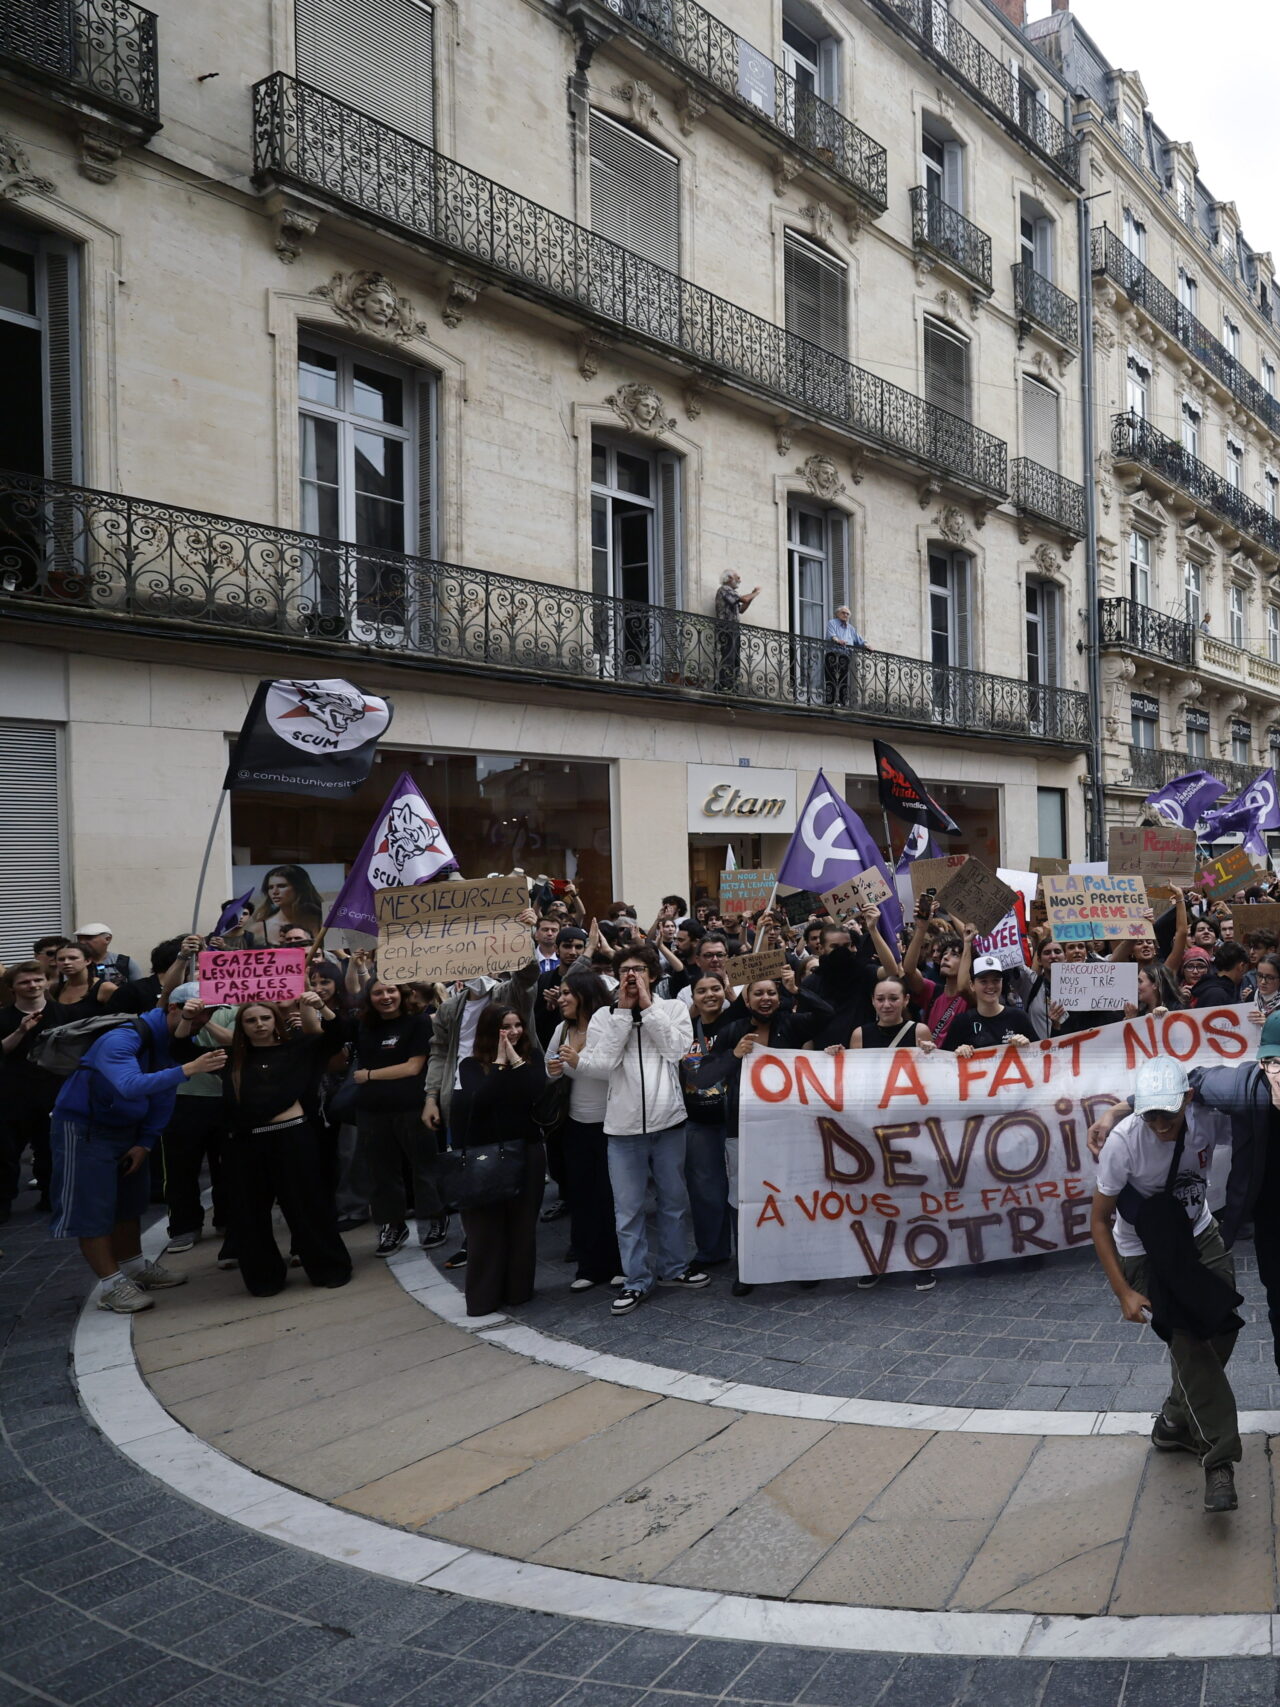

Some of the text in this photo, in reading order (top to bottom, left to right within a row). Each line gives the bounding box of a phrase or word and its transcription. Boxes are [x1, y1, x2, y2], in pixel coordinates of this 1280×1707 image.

[291, 730, 340, 750] SCUM
[703, 784, 787, 817] Etam
[1050, 876, 1078, 893] LA
[492, 887, 525, 905] LES
[1050, 892, 1144, 907] NOUS PROTÈGE
[1078, 905, 1127, 919] CRÈVE
[1053, 924, 1101, 939] YEUX
[484, 935, 526, 956] RIO
[212, 952, 276, 967] GAZEZ
[425, 965, 442, 977] un
[445, 960, 484, 976] fashion
[1061, 964, 1116, 975] PARCOURSUP
[215, 978, 287, 993] PAS LES
[1060, 976, 1079, 986] NOUS
[1060, 985, 1088, 994] L'ÉTAT
[1058, 998, 1080, 1007] NOUS
[750, 1051, 844, 1113] ON
[878, 1049, 928, 1109] A
[1125, 1008, 1248, 1069] NOS
[756, 1180, 784, 1228] À
[794, 1190, 899, 1222] VOUS
[920, 1190, 964, 1214] DE
[850, 1197, 1094, 1275] VÔTRE
